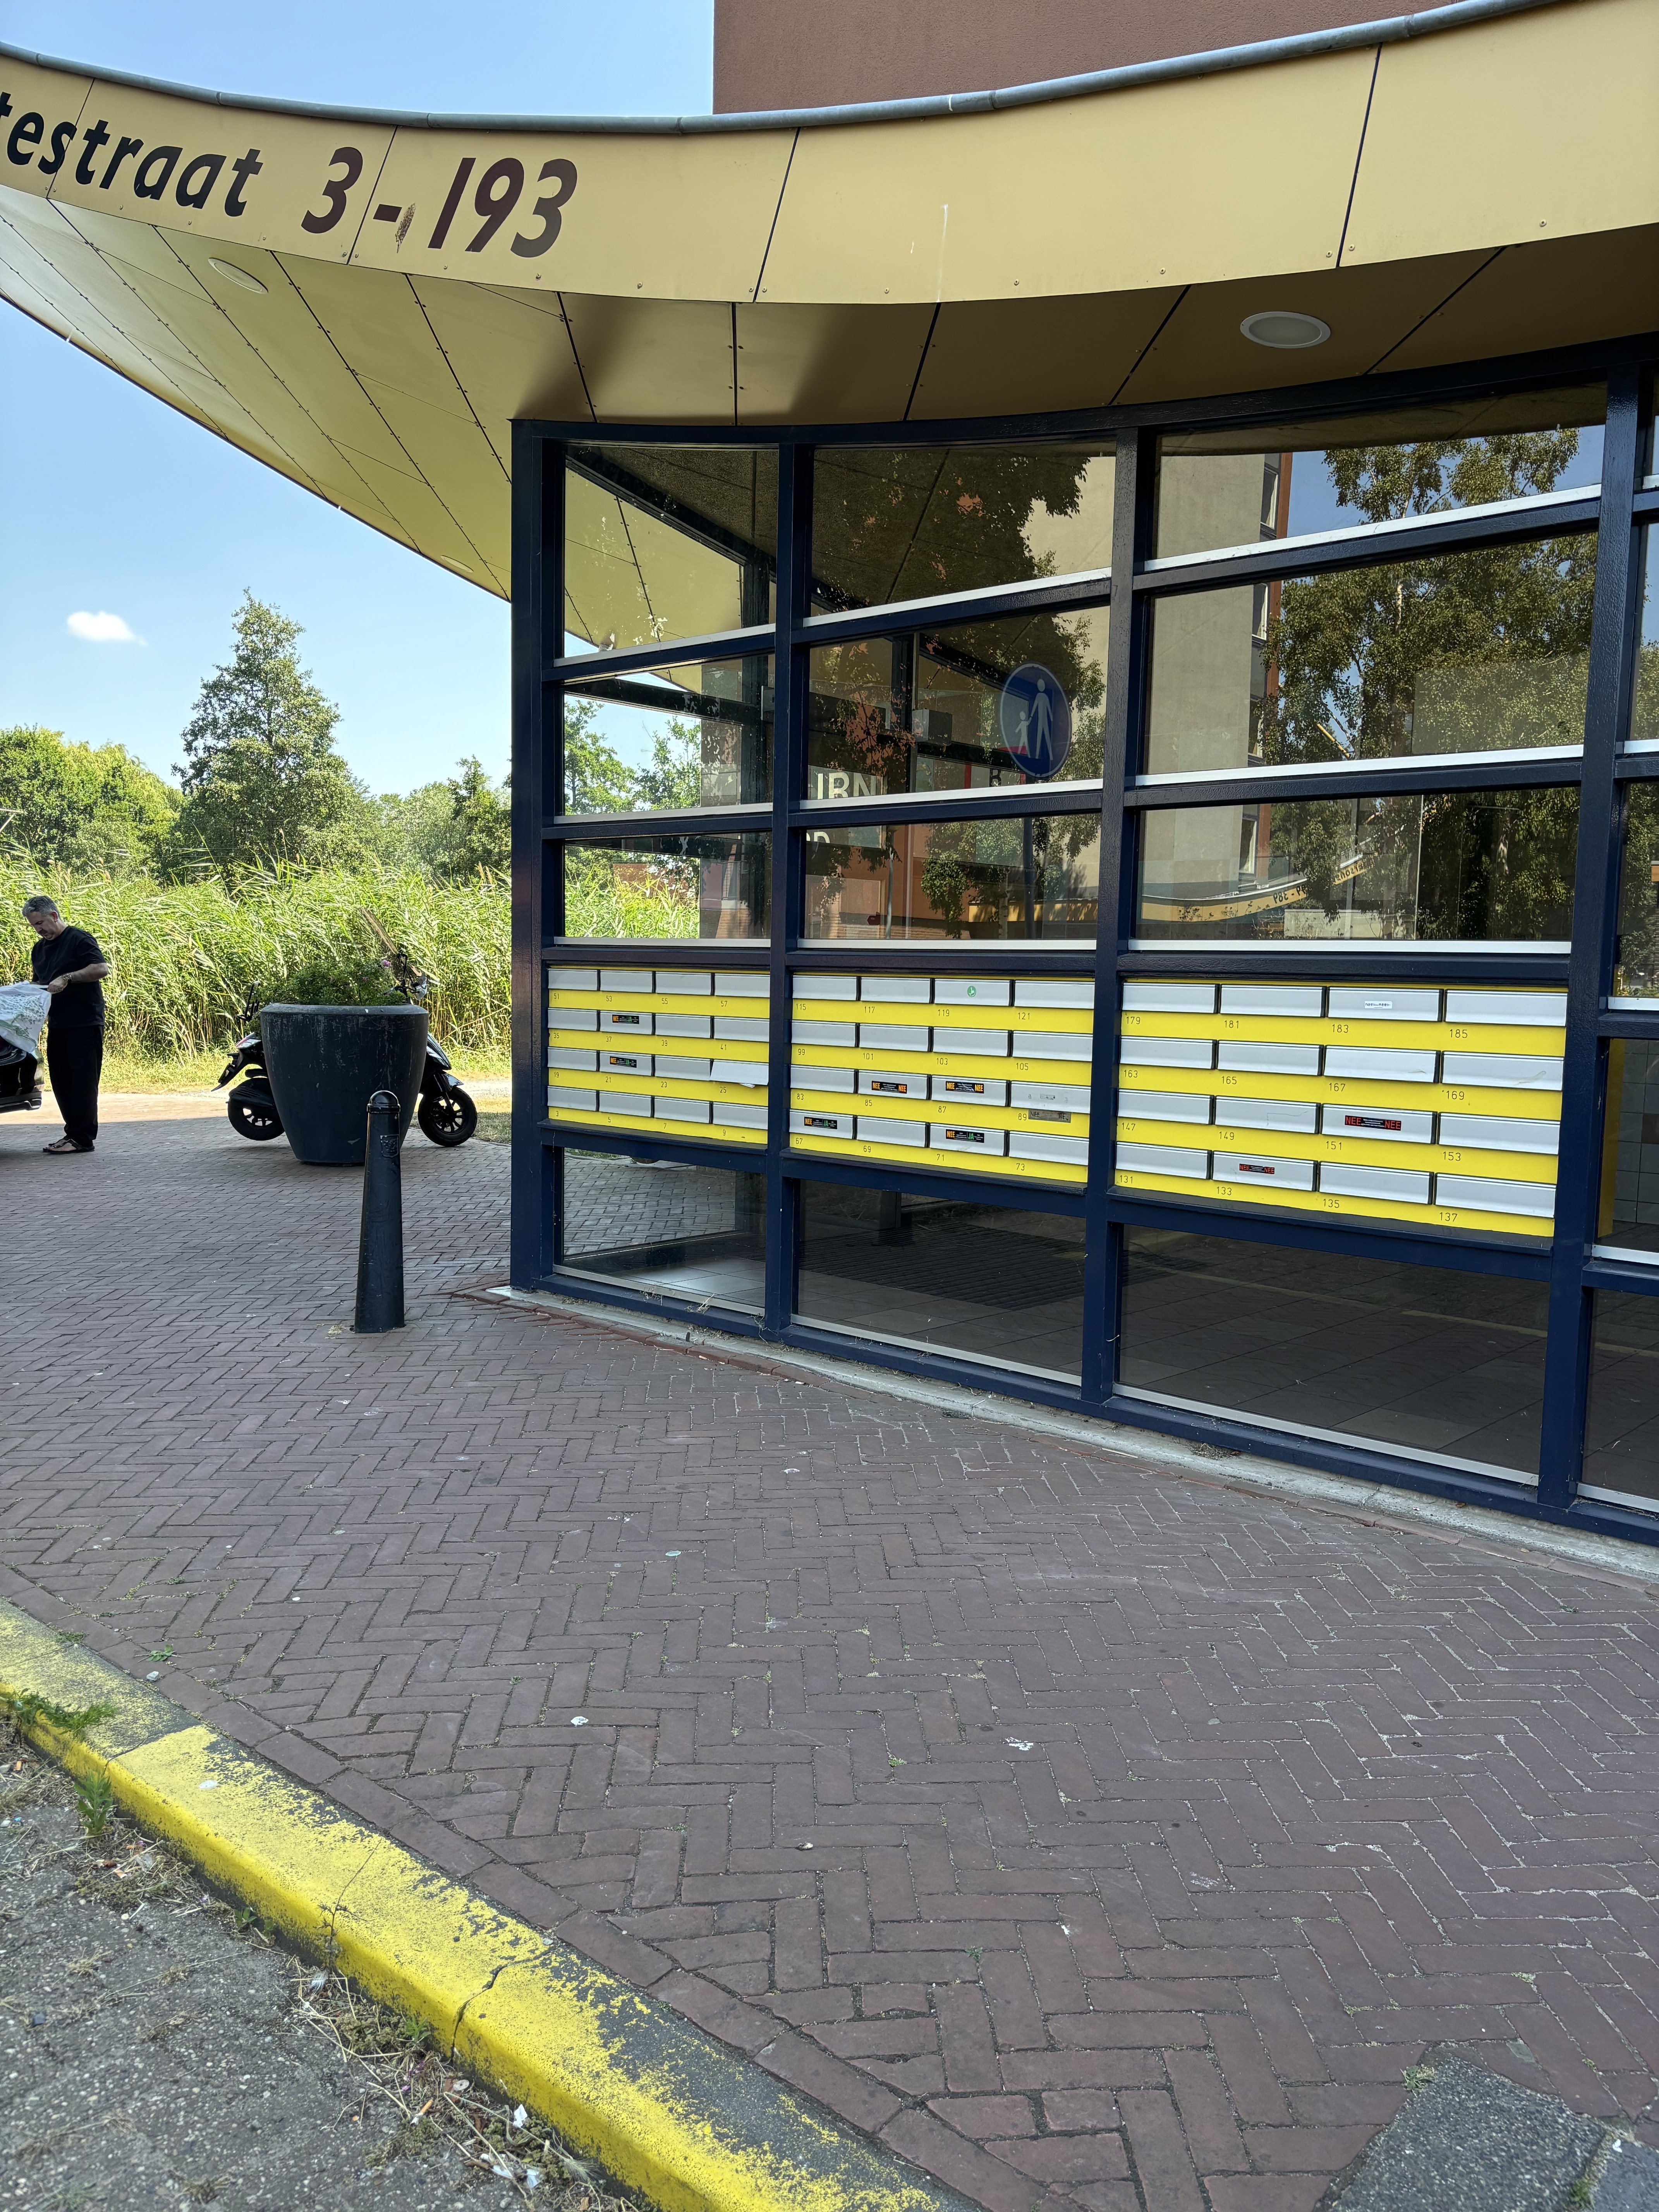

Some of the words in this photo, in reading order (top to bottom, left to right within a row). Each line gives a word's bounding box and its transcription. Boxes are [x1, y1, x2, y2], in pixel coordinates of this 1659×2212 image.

[428, 157, 578, 258] 193
[1018, 1012, 1030, 1020] 121
[1125, 1017, 1140, 1025] 179
[1224, 1020, 1239, 1029] 181
[1332, 1024, 1349, 1033] 183
[1449, 1029, 1468, 1038] 185
[1016, 1062, 1029, 1070] 105
[1123, 1070, 1138, 1079] 163
[1222, 1076, 1237, 1085] 165
[1329, 1082, 1346, 1092] 167
[1446, 1090, 1465, 1100] 169
[1345, 1116, 1362, 1125] NEE
[1384, 1120, 1401, 1129] NEE
[1121, 1123, 1136, 1132] 147
[1219, 1131, 1234, 1140] 149
[1326, 1141, 1341, 1151] 151
[937, 1153, 944, 1161] 71
[1443, 1151, 1461, 1161] 153
[1016, 1163, 1025, 1171] 73
[1119, 1175, 1133, 1184] 131
[1216, 1186, 1232, 1195] 133
[1323, 1199, 1340, 1208] 135
[1439, 1212, 1458, 1222] 137
